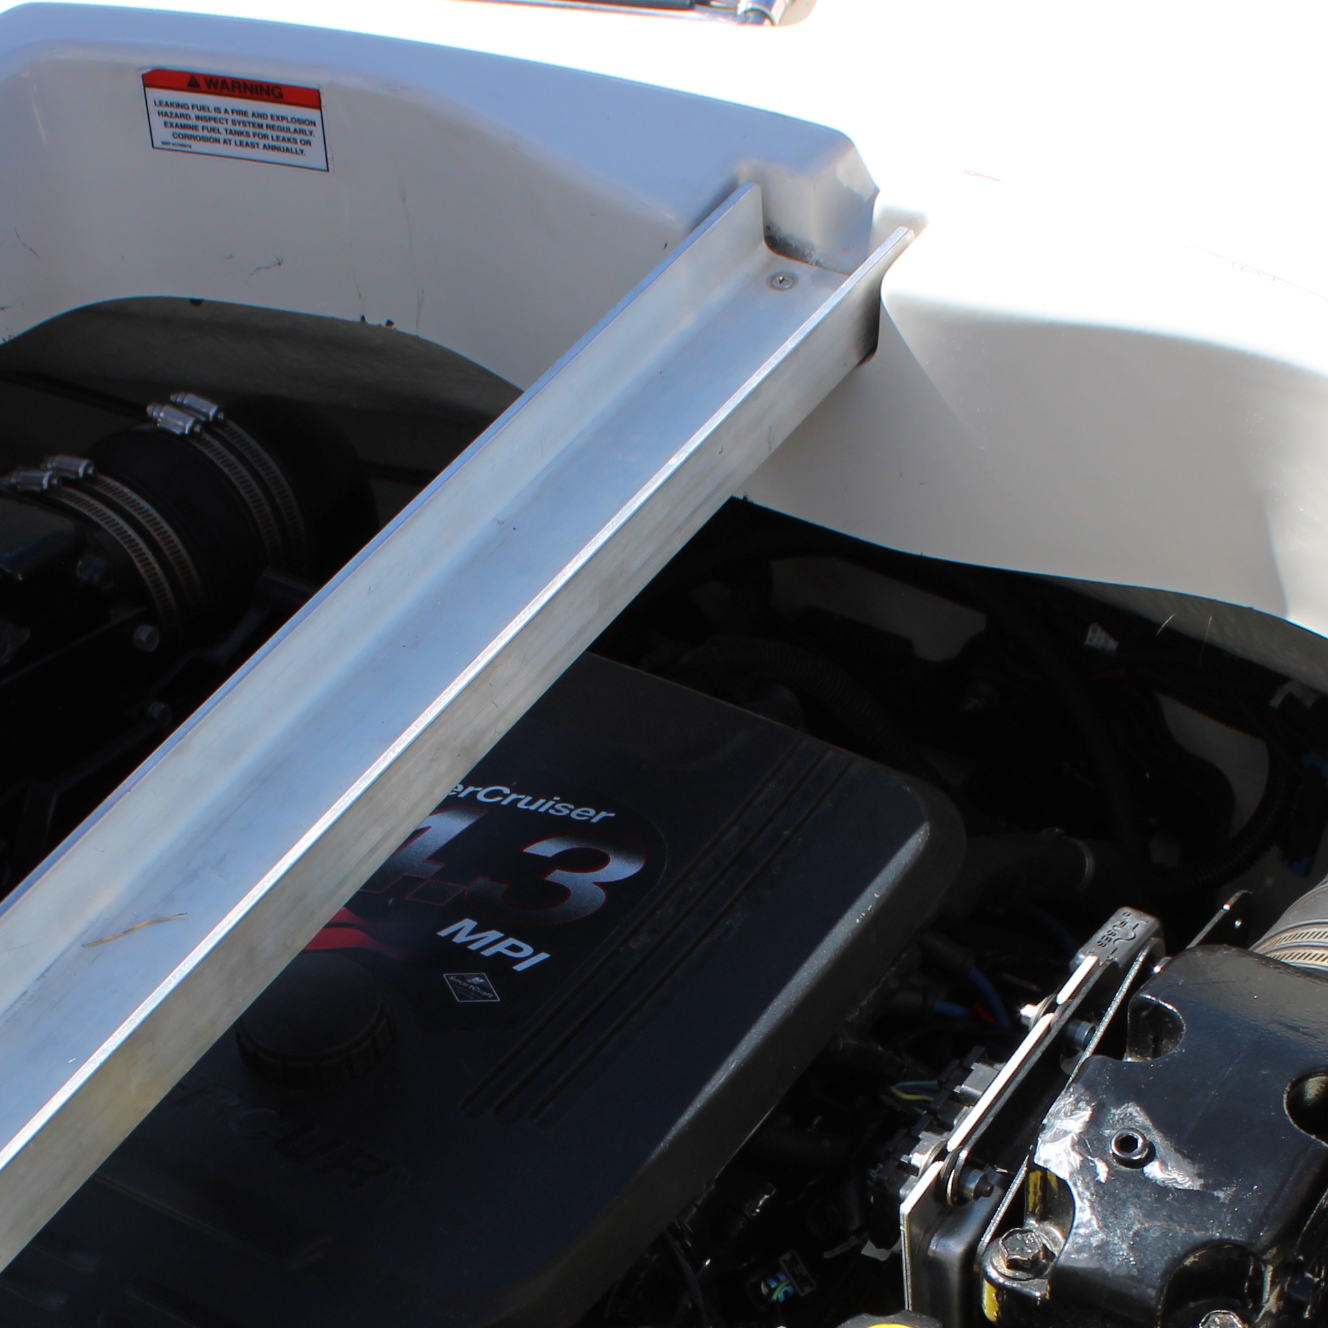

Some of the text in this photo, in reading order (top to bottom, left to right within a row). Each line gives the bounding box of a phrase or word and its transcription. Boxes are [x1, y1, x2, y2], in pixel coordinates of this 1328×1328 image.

[204, 76, 284, 99] WARNING
[153, 100, 317, 127] LEAKING FUEL IS A FIRE AND EXPLOSION
[157, 110, 315, 137] HAZARD. INSPECT SYSTEM REGULARLY.
[163, 121, 312, 147] EXAMINE FUEL TANKS FOR LEAKS OR
[172, 131, 221, 145] CORROSION
[222, 137, 232, 146] AT
[234, 139, 260, 150] LEAST
[262, 142, 306, 156] ANNUALLY.
[447, 781, 616, 825] erCruiser
[436, 918, 551, 972] MPI
